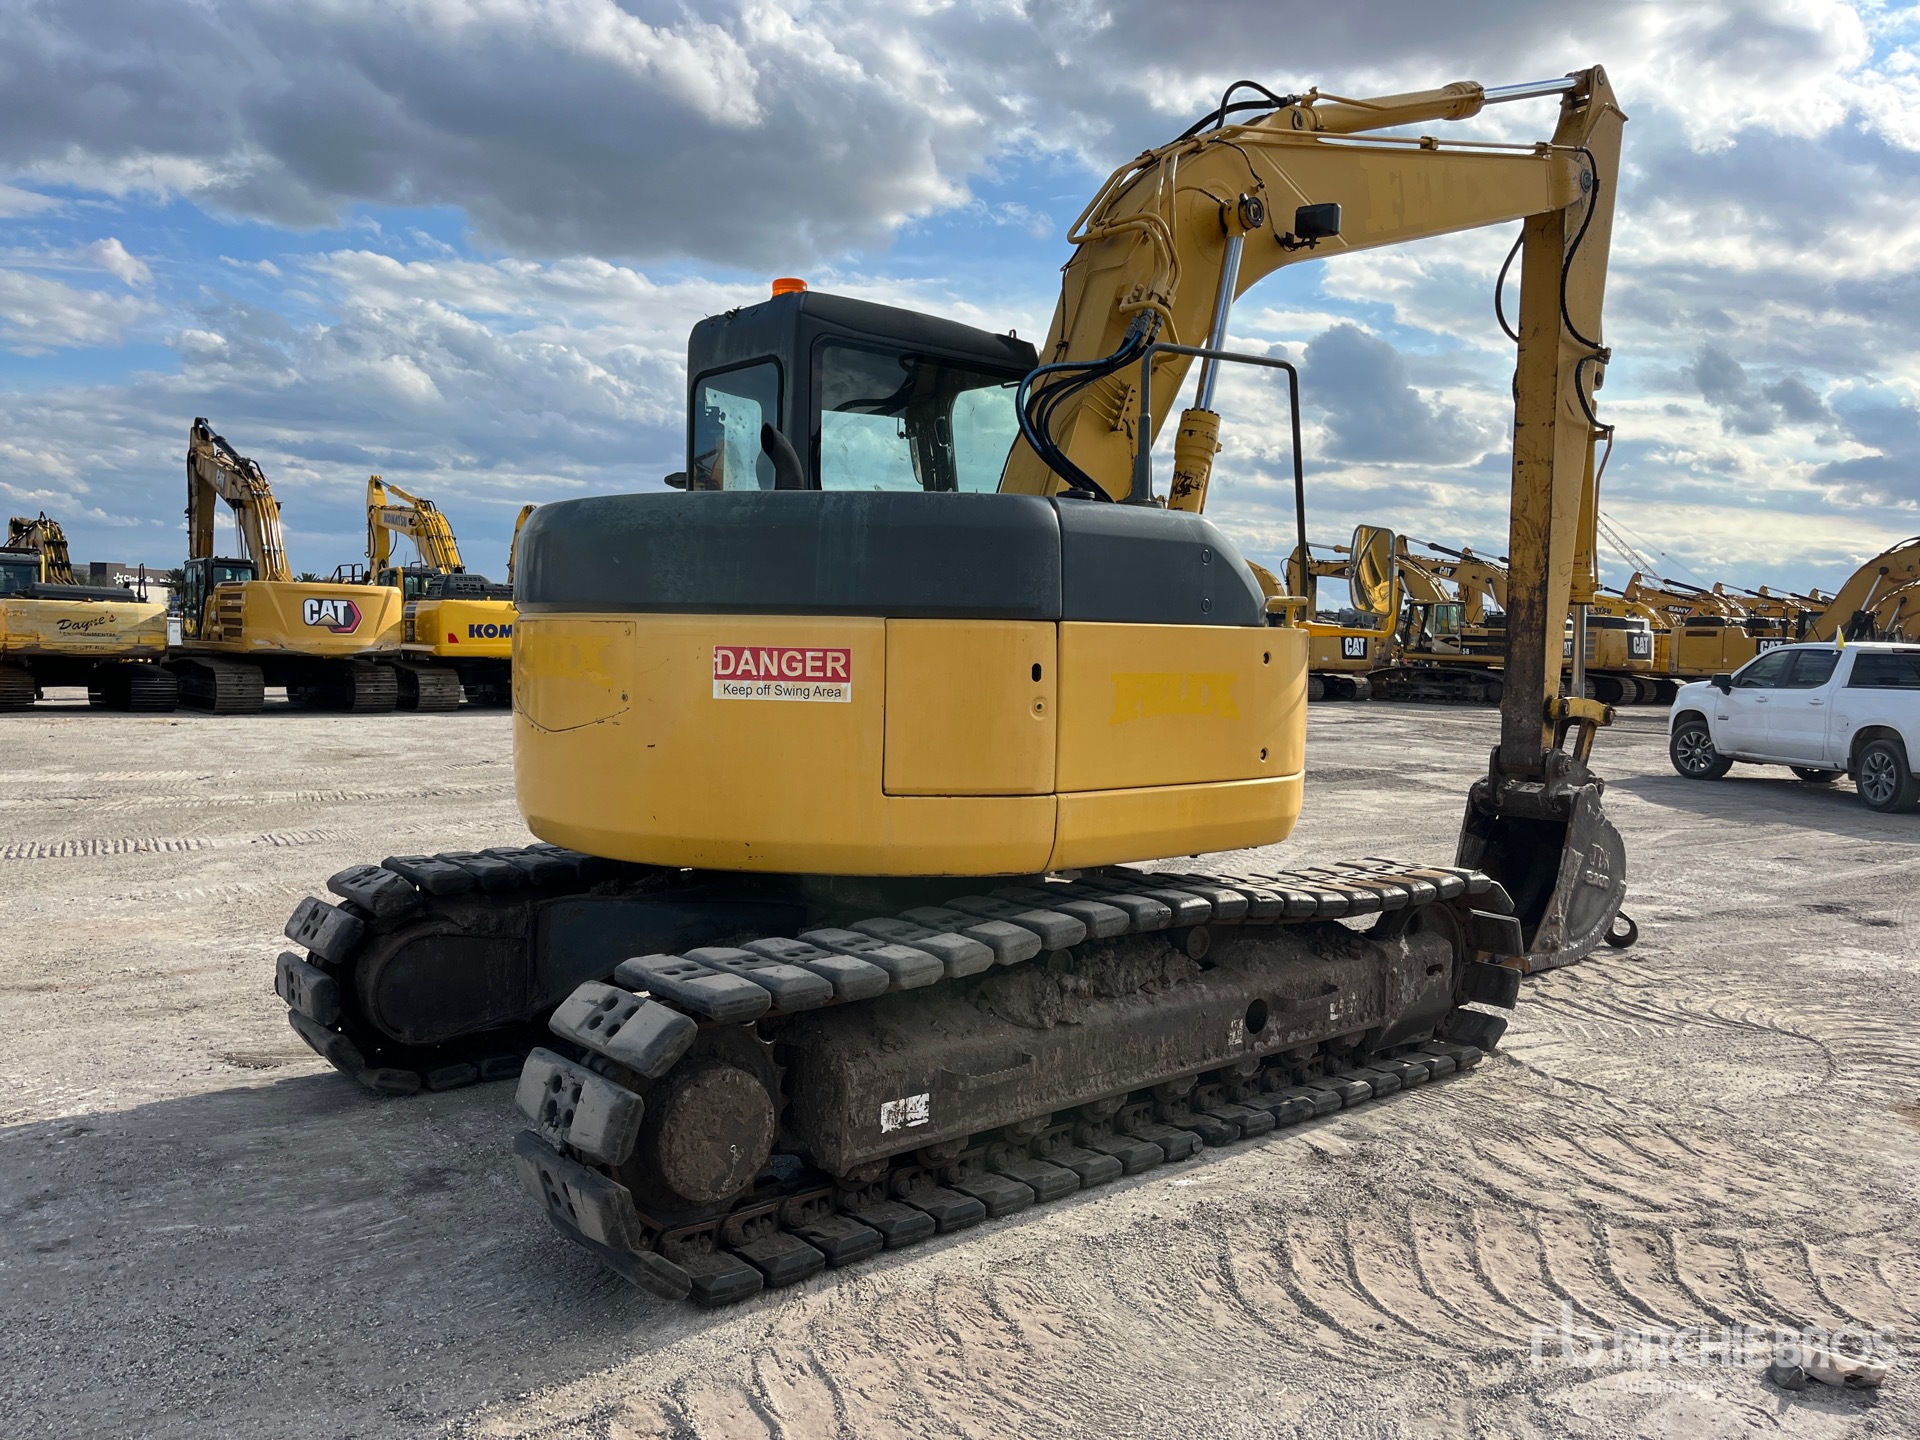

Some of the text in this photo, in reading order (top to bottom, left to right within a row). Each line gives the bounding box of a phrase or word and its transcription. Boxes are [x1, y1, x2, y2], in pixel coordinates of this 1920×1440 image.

[1439, 567, 1452, 577] CAT
[304, 600, 347, 626] CAT
[1668, 606, 1690, 614] SANY
[1345, 637, 1365, 656] CAT
[1633, 636, 1649, 654] CAT
[716, 649, 848, 678] DANGER
[723, 683, 842, 699] Keep off Swing Area
